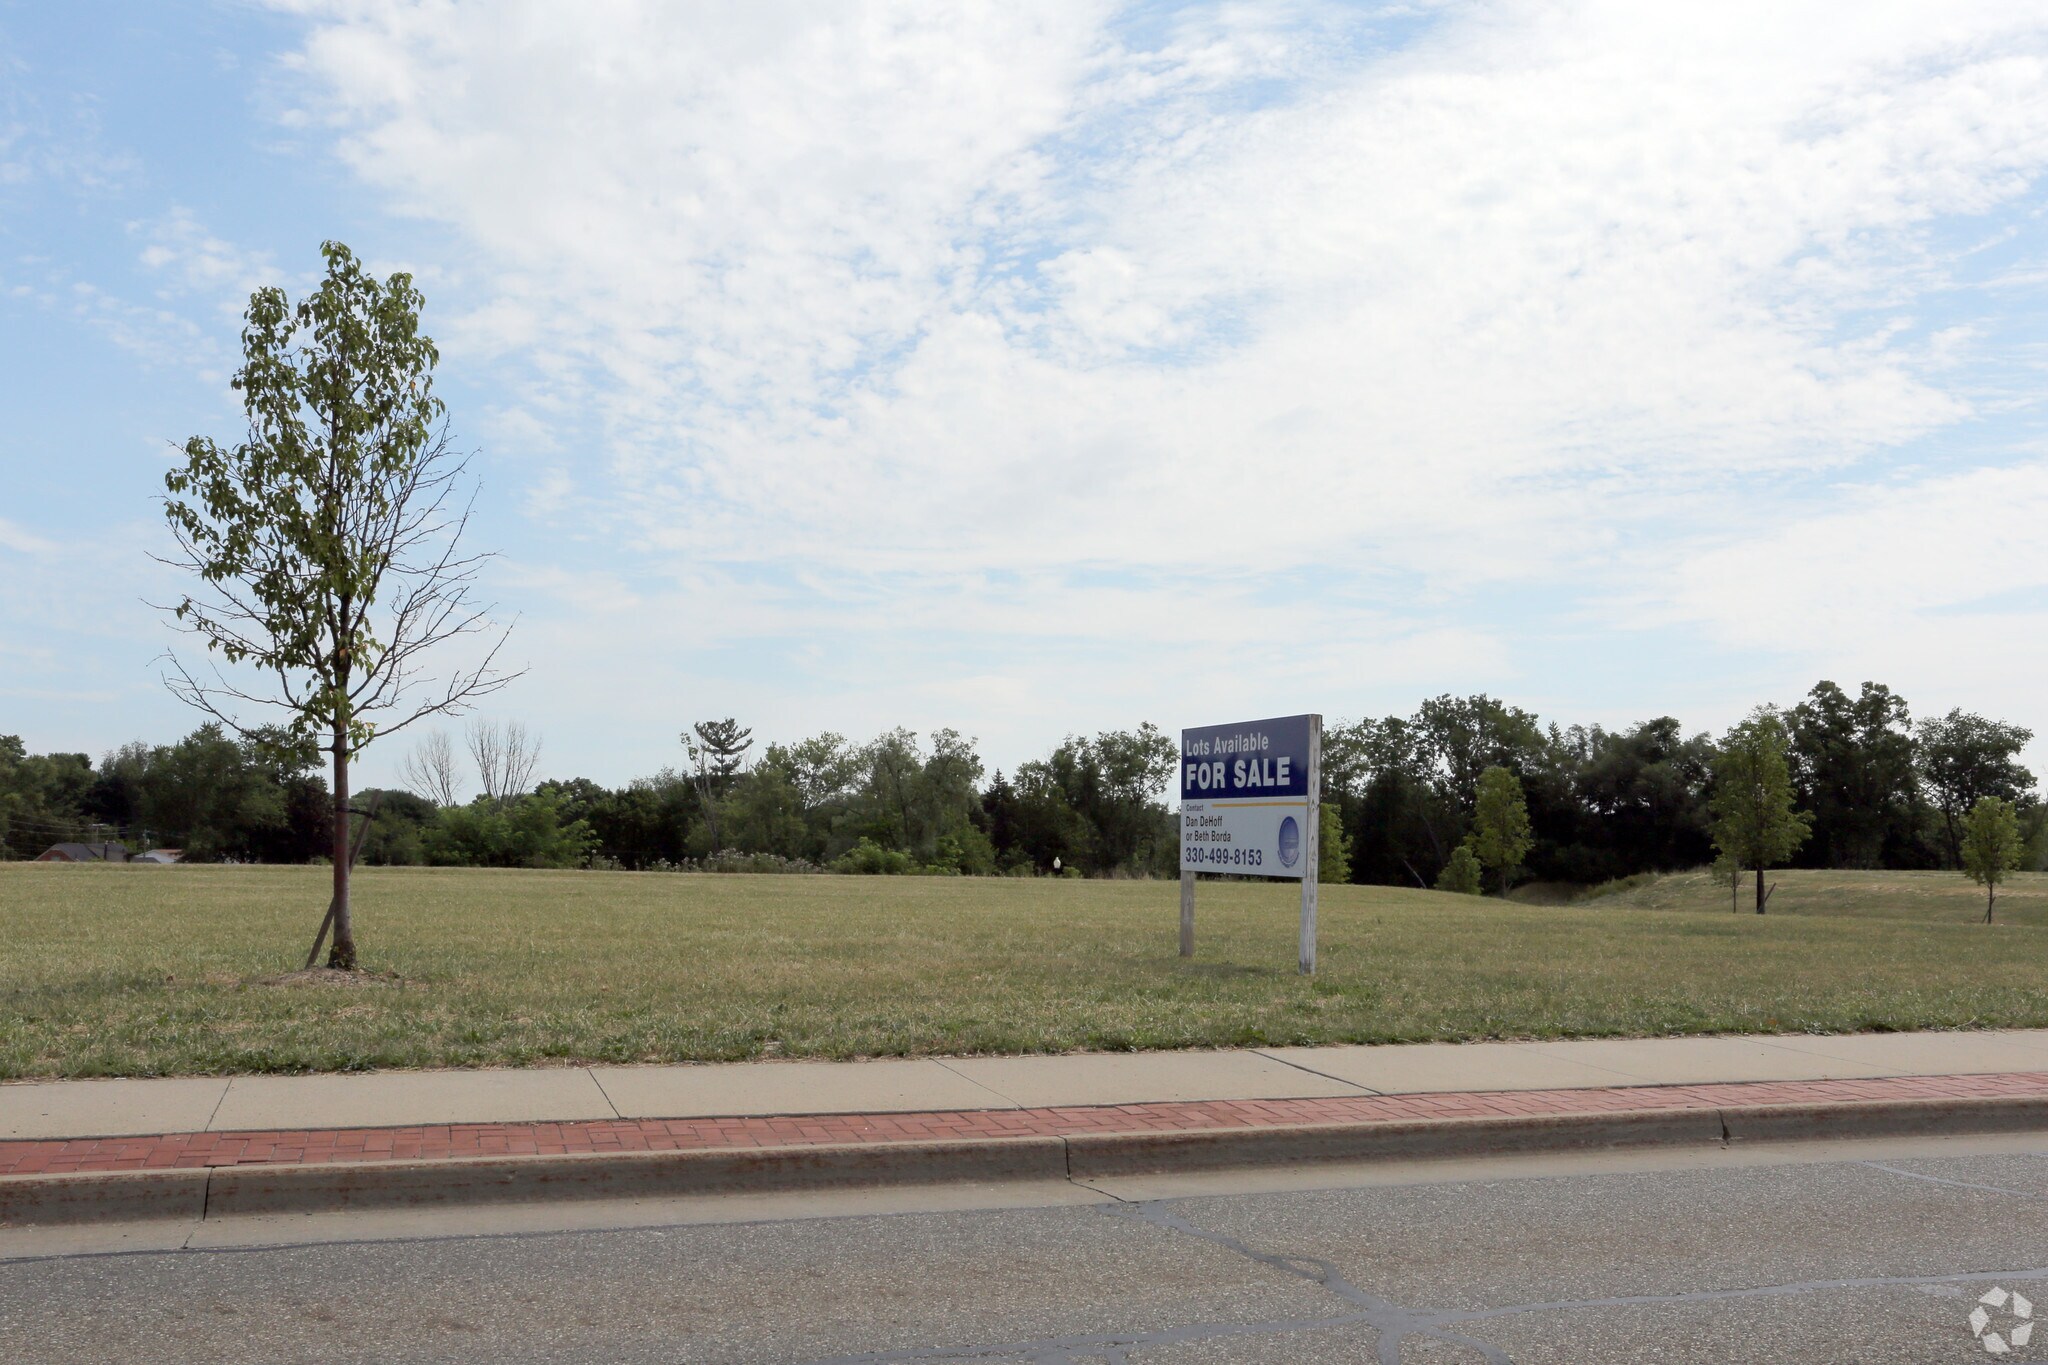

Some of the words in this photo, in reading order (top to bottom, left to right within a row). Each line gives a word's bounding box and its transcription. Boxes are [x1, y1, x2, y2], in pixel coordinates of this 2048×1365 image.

[1186, 740, 1209, 756] Lots
[1214, 733, 1268, 754] Available
[1186, 762, 1225, 790] FOR
[1234, 757, 1290, 788] SALE
[1186, 816, 1198, 827] Dan
[1200, 816, 1222, 826] DeHoff
[1186, 833, 1192, 841] or
[1195, 831, 1209, 841] Beth
[1212, 831, 1230, 842] Borda
[1186, 847, 1262, 865] 330-499-8153
